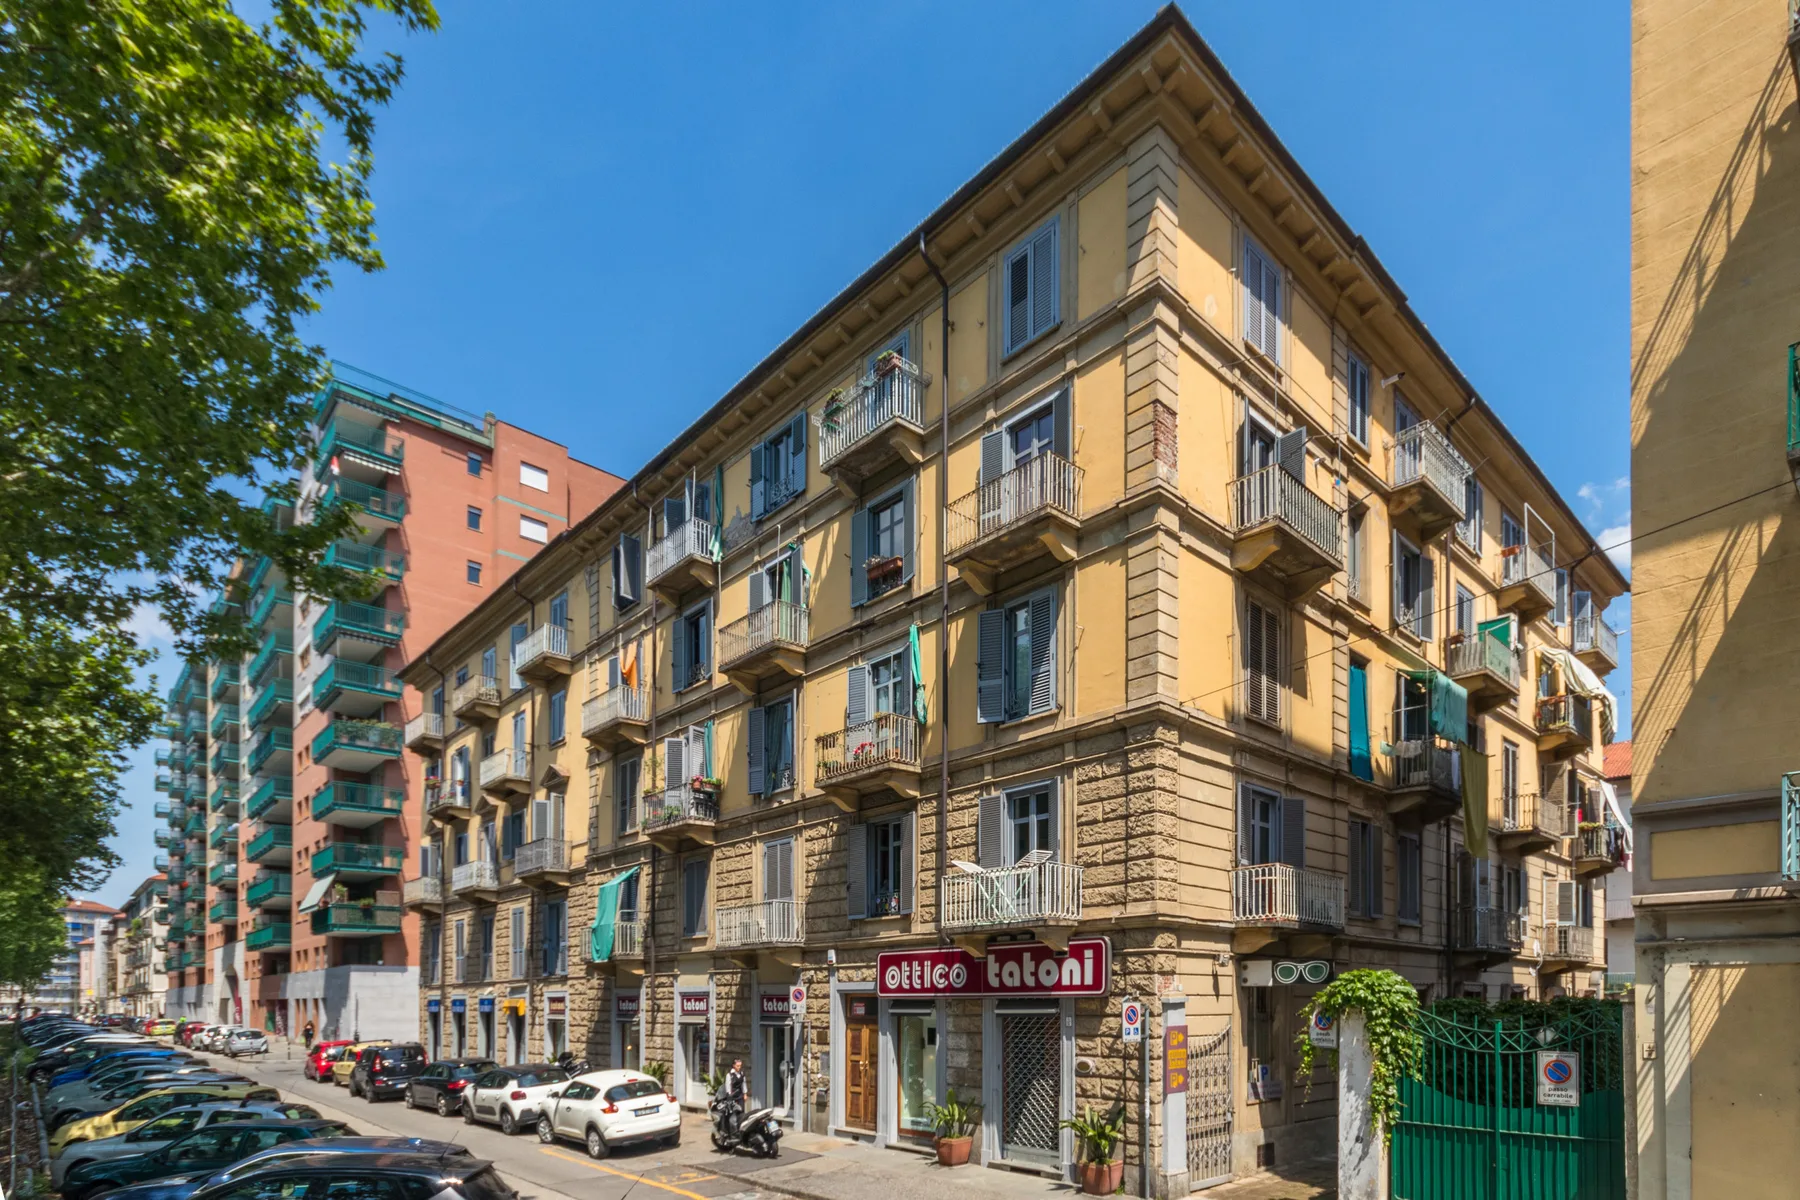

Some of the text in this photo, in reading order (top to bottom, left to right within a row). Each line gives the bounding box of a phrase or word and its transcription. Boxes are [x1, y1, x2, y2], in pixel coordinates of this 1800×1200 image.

[885, 949, 1093, 989] ottico tatoni
[683, 998, 707, 1011] tatoni
[763, 998, 789, 1012] taton
